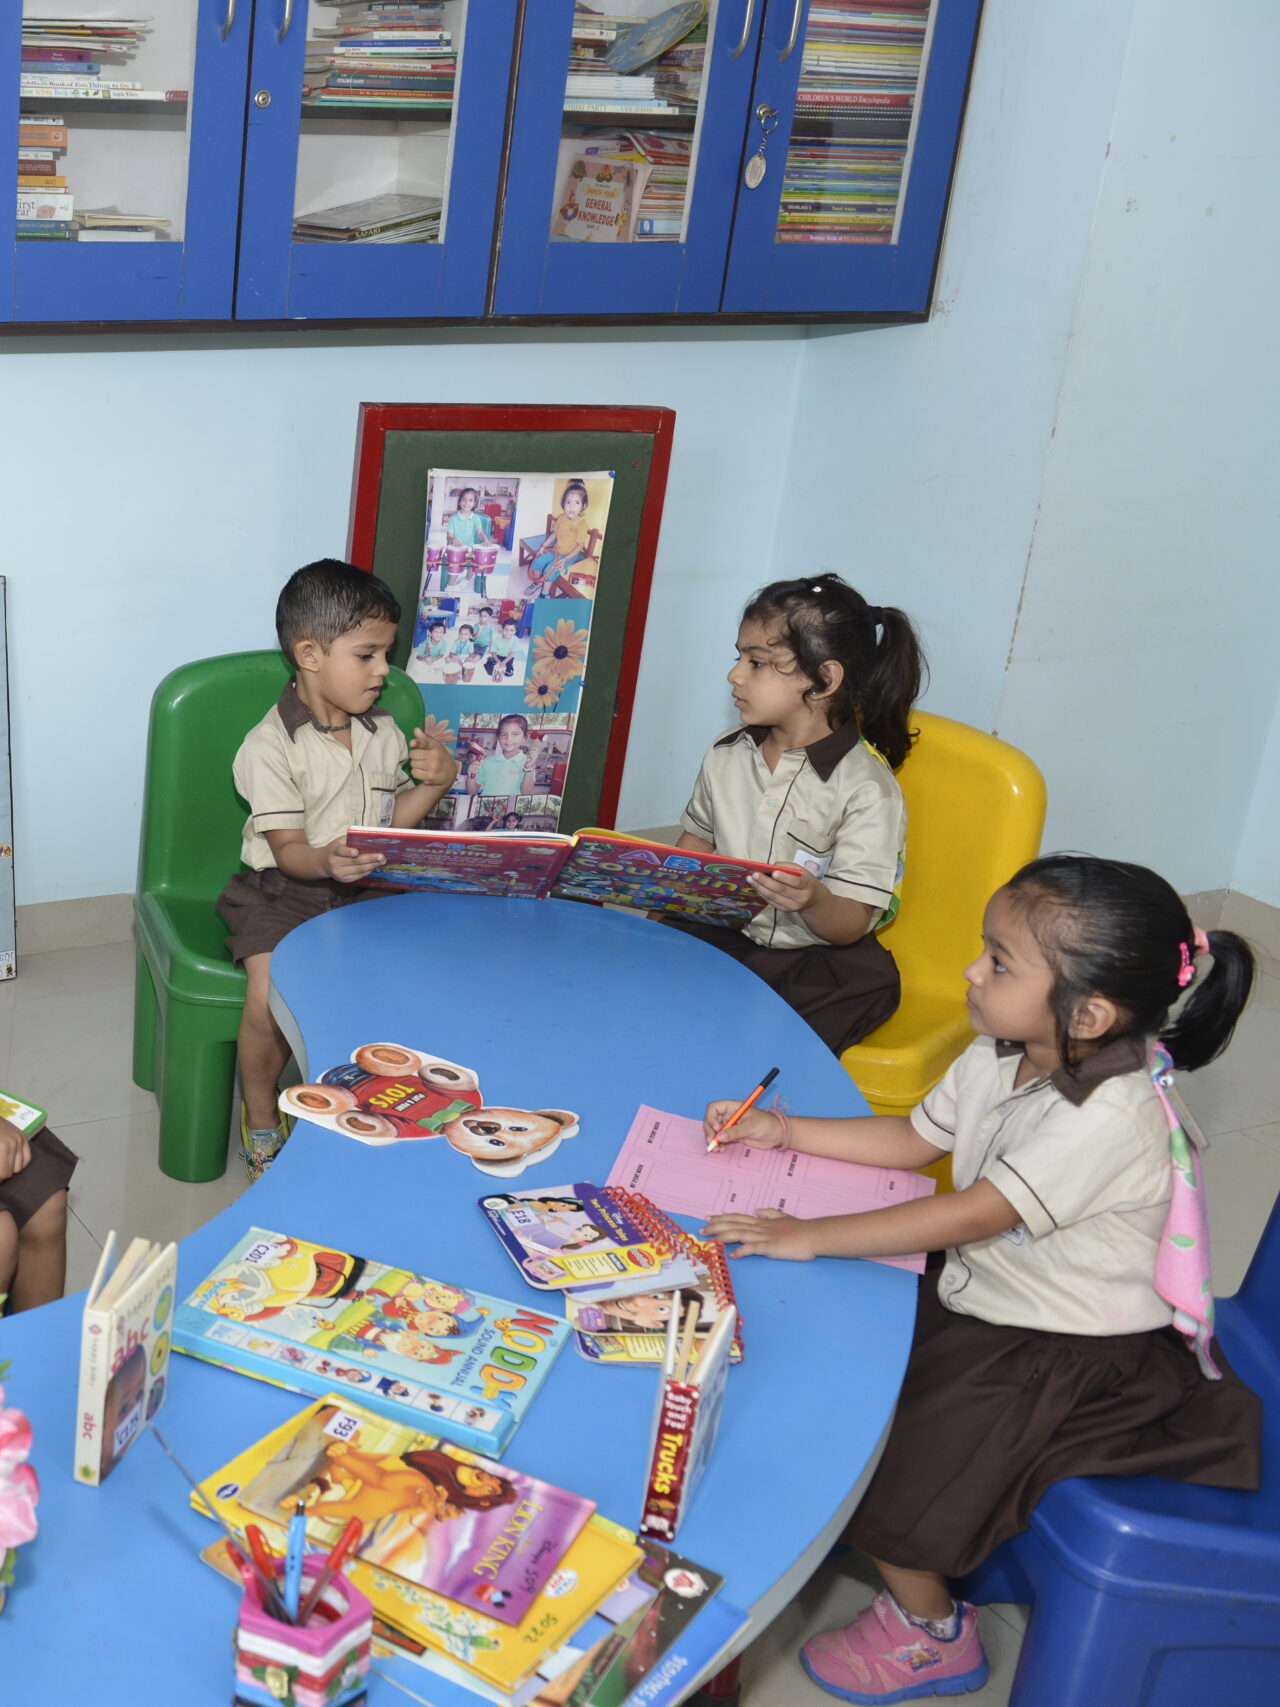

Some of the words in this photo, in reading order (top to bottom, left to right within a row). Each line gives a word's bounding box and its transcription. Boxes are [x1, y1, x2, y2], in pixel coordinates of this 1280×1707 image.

[578, 210, 615, 227] KNOWLEDGE
[585, 197, 612, 213] GENERAL
[355, 227, 381, 239] SAFARI
[618, 849, 749, 880] ABC
[658, 866, 689, 876] and
[368, 1083, 416, 1109] TOYS
[511, 1209, 531, 1226] E18
[110, 1317, 151, 1375] abc
[472, 1328, 496, 1356] SOUND
[451, 1355, 479, 1388] ANNUAL
[469, 1309, 560, 1409] NODDY
[665, 1401, 693, 1414] Touch
[666, 1391, 693, 1407] Baby
[82, 1412, 97, 1440] abc
[333, 1416, 358, 1438] F93
[652, 1433, 685, 1495] Trucks
[504, 1500, 545, 1539] LION
[473, 1535, 516, 1580] KING
